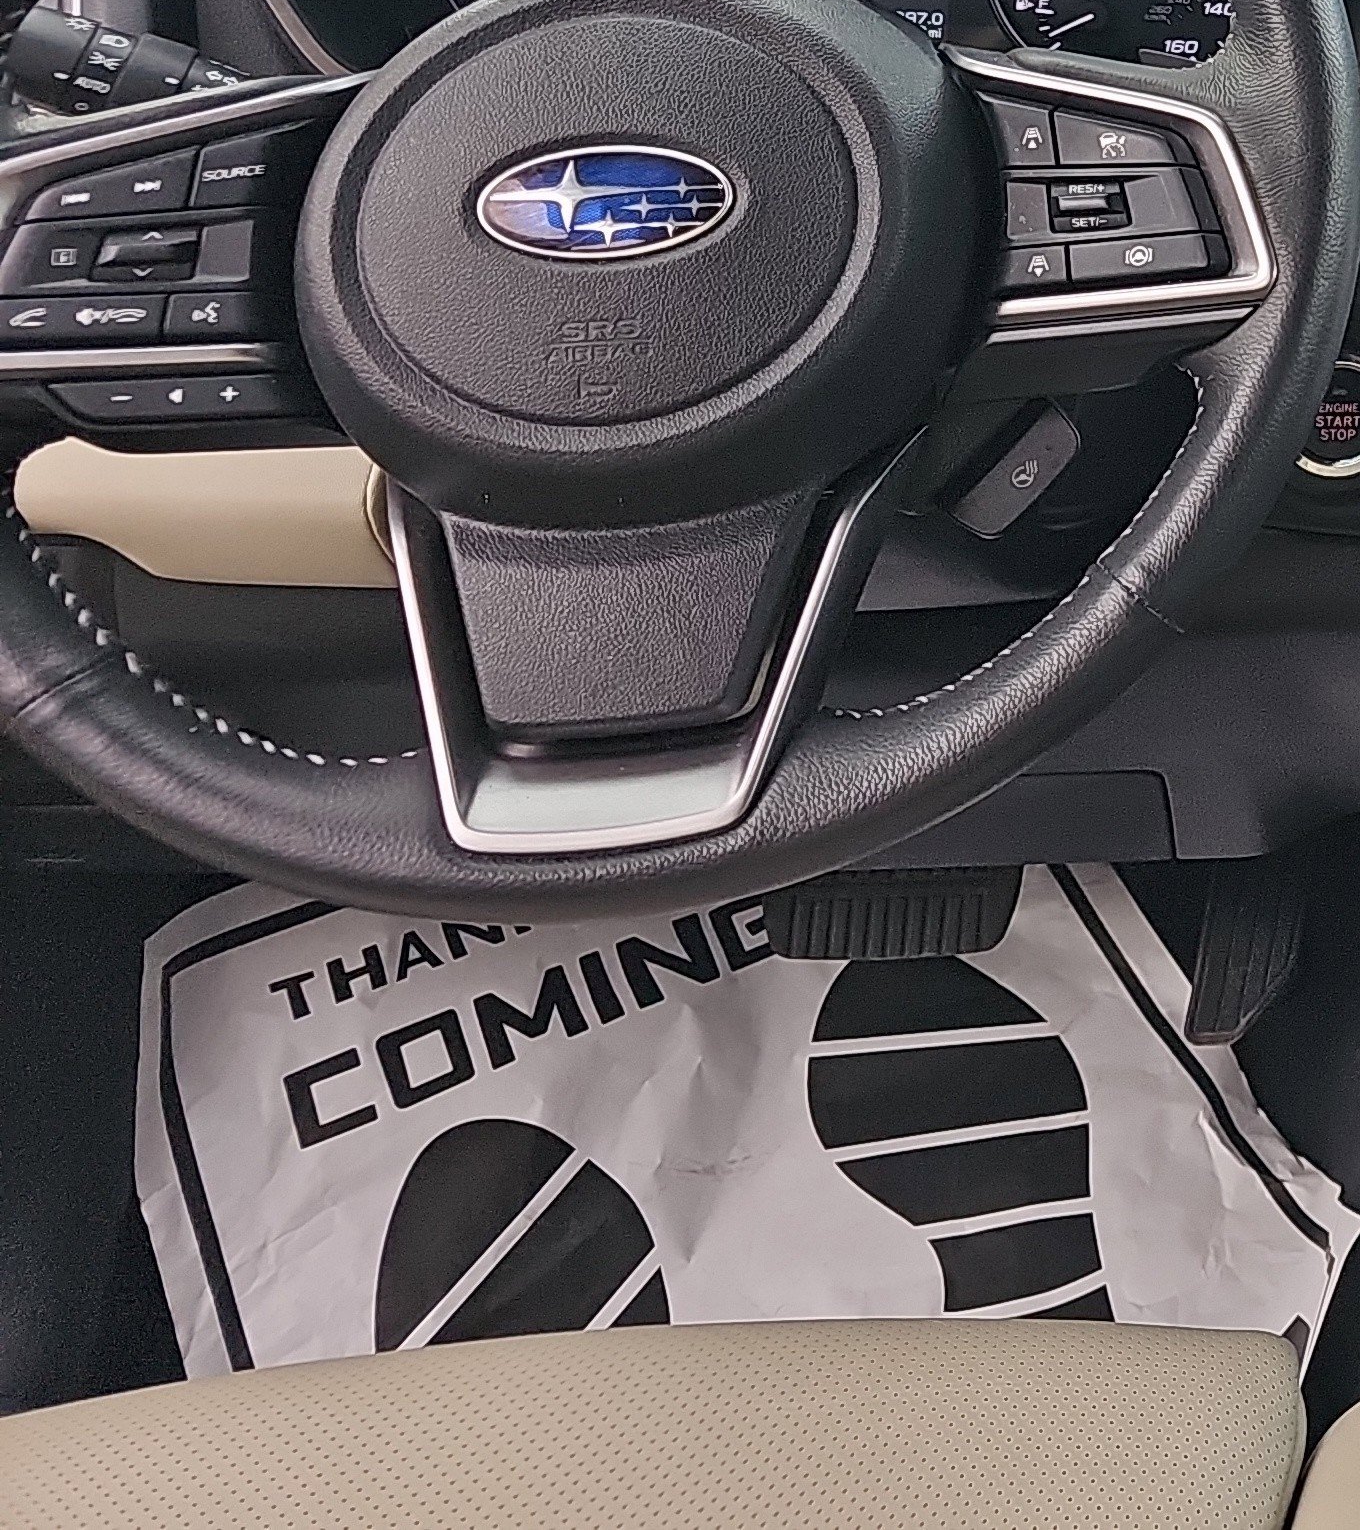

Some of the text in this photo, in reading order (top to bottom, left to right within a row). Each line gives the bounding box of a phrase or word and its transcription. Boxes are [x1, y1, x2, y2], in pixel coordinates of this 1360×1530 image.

[1038, 0, 1050, 10] F
[896, 11, 943, 25] 97.0
[1164, 40, 1198, 53] 160
[202, 164, 266, 182] SOURCE
[560, 320, 642, 340] SRS
[1319, 402, 1360, 413] ENGINE
[1315, 415, 1360, 427] START
[1320, 429, 1357, 441] STOP
[269, 922, 532, 1020] THAN
[282, 901, 772, 1150] COMING
